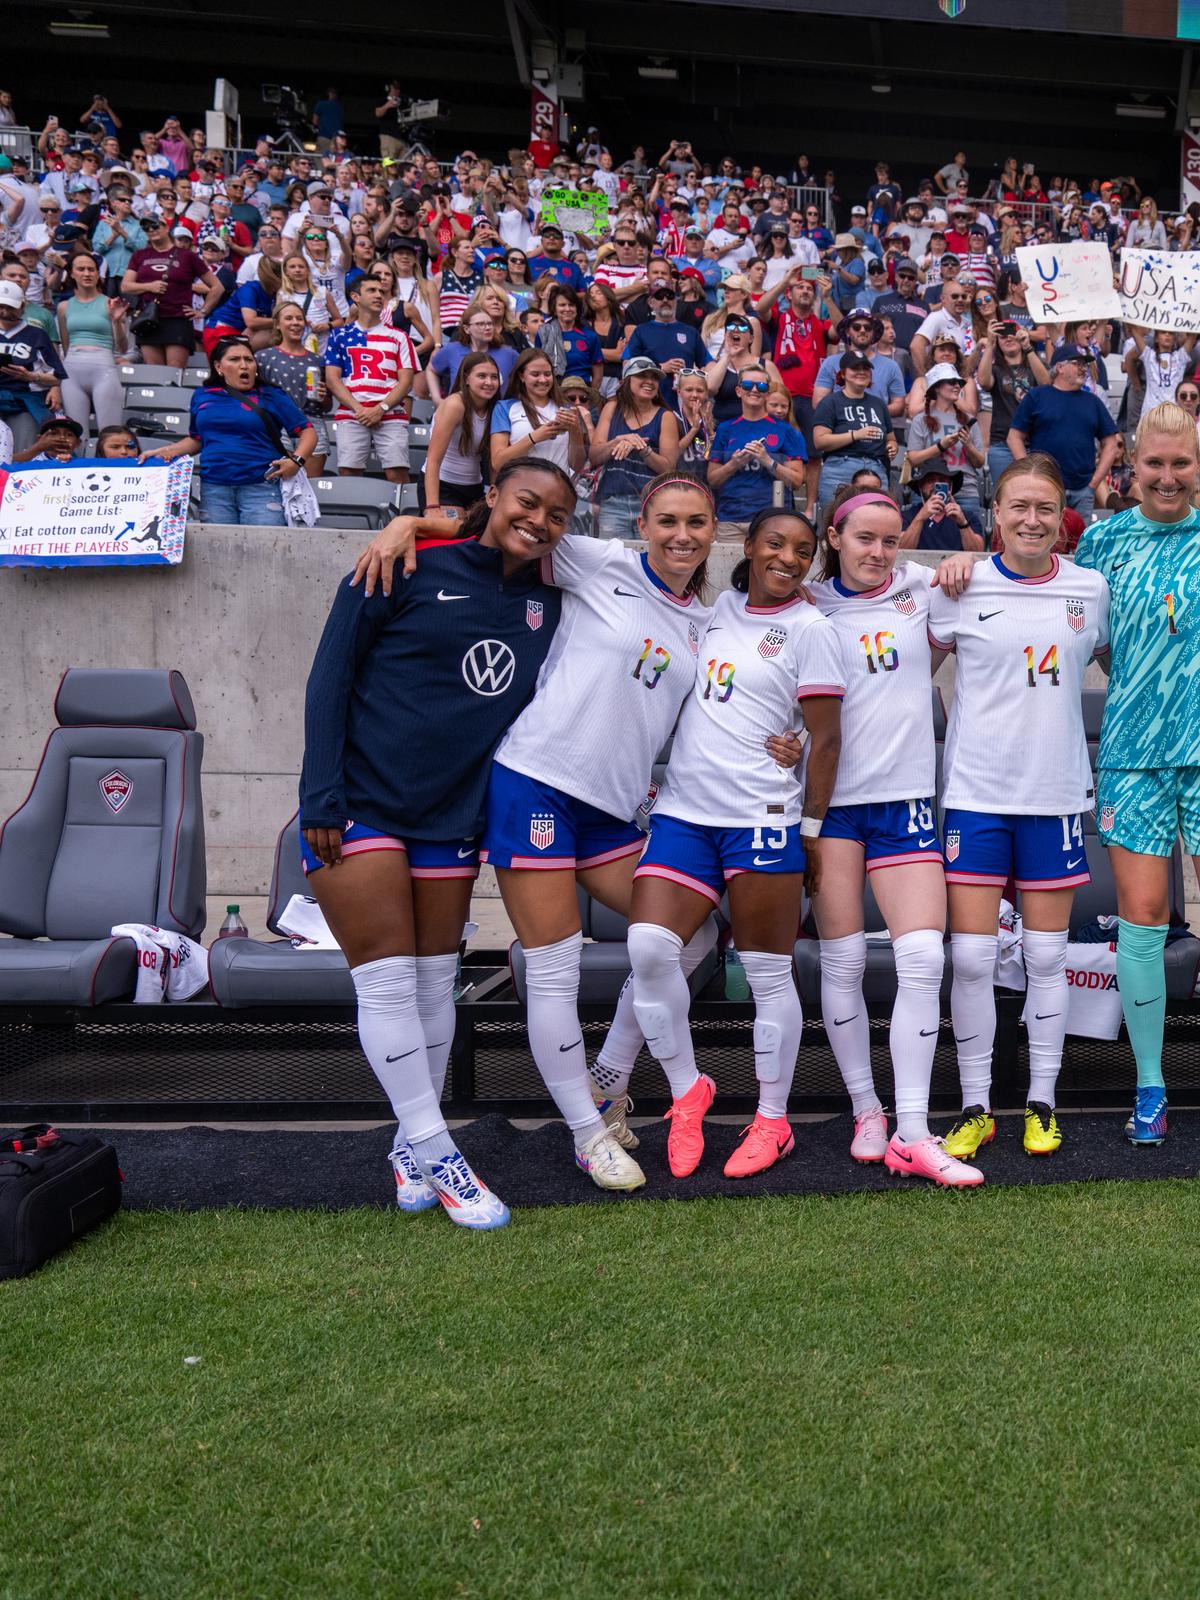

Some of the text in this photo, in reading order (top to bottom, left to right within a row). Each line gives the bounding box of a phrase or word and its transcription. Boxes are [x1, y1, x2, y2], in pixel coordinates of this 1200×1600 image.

[1036, 256, 1059, 281] U
[1121, 261, 1177, 302] USA
[1041, 283, 1057, 301] S
[1043, 303, 1059, 316] A
[1179, 302, 1198, 314] The
[347, 347, 388, 380] R
[844, 406, 885, 424] USA
[124, 476, 142, 485] my
[4, 476, 43, 504] USWNT
[71, 494, 110, 504] soccer
[113, 492, 149, 504] game!
[60, 506, 122, 517] Game List:
[15, 526, 33, 536] Eat
[38, 525, 78, 536] cotton
[81, 523, 115, 535] candy
[13, 541, 129, 555] MEET THE PLAYERS
[892, 592, 910, 602] USA
[528, 601, 544, 614] USA
[1068, 606, 1083, 617] USA
[1164, 593, 1178, 635] 1
[765, 635, 784, 645] USA
[859, 631, 899, 674] 16
[632, 638, 671, 689] 13
[1024, 645, 1060, 688] 14
[703, 659, 735, 703] 19
[907, 799, 933, 834] 16
[532, 821, 552, 833] USA
[1060, 814, 1083, 851] 14
[1065, 968, 1120, 992] BODYA
